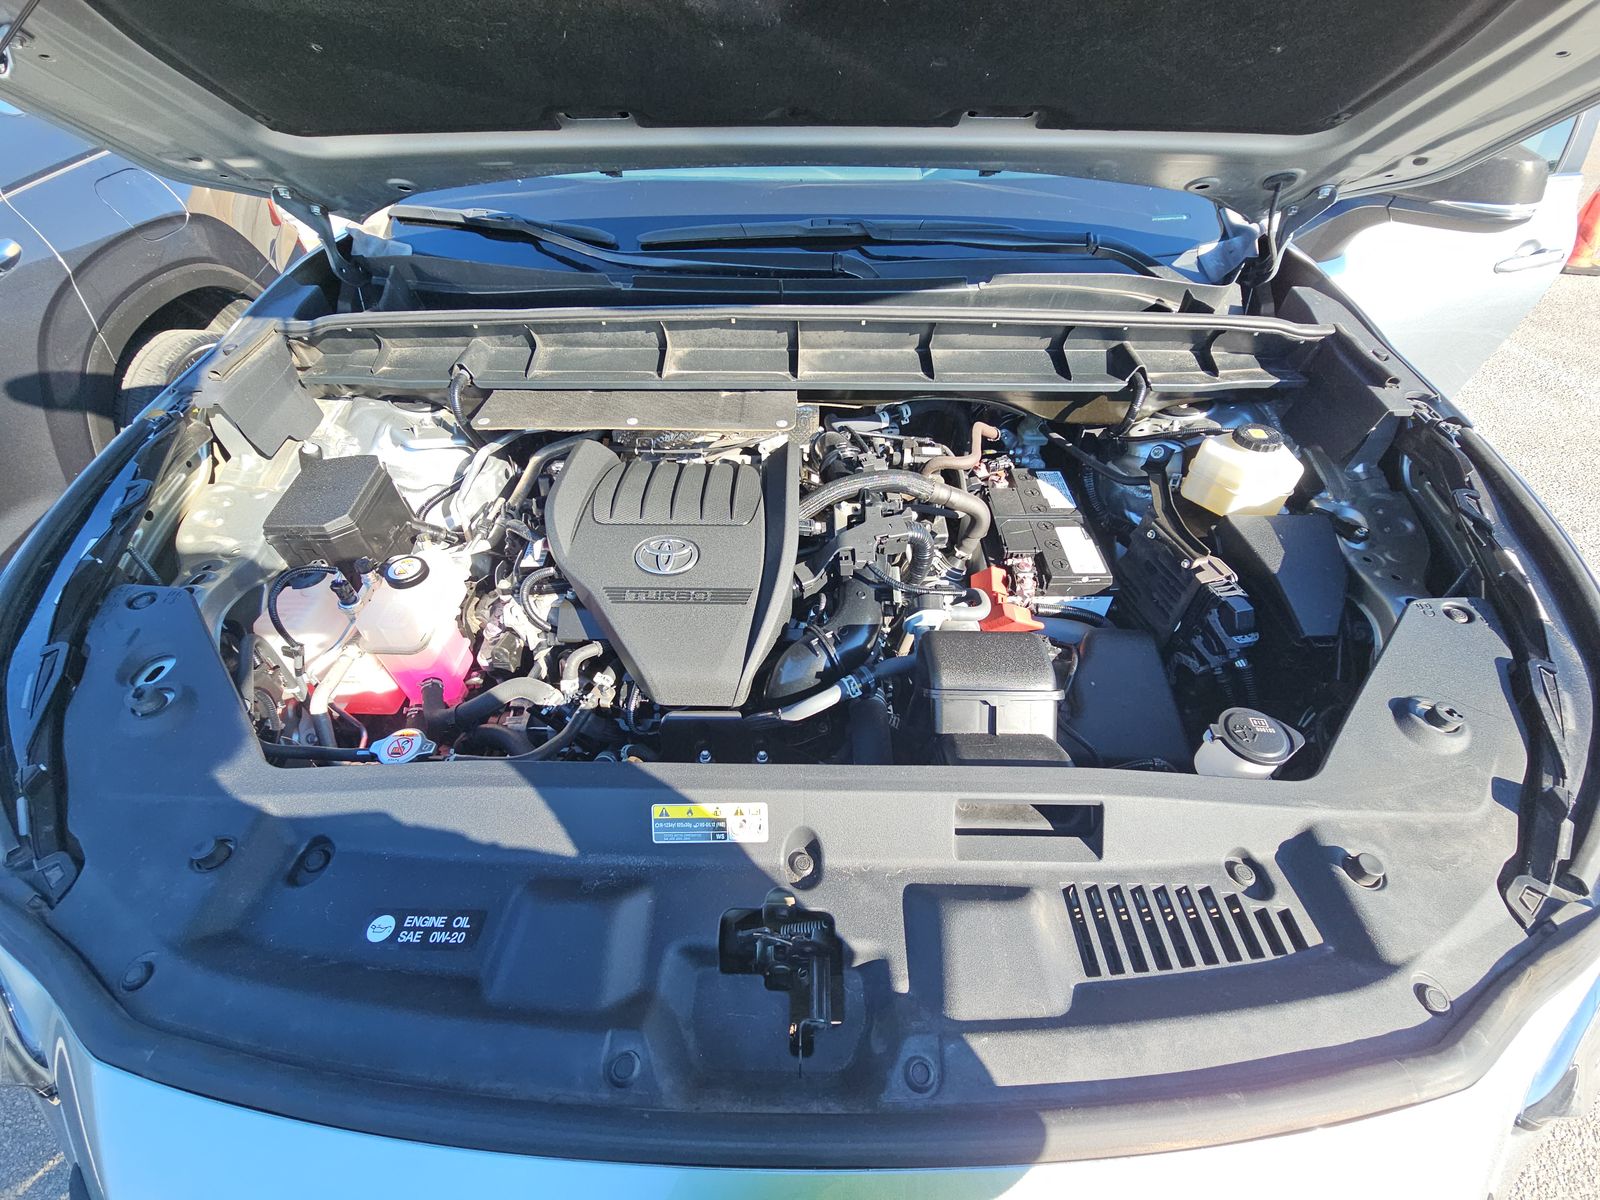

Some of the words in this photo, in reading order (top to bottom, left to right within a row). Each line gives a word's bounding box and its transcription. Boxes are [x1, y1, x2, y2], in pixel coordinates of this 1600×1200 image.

[628, 590, 709, 601] TURBO
[403, 915, 448, 928] ENGINE
[452, 916, 471, 928] OIL
[397, 931, 423, 943] SAE
[429, 931, 466, 943] 0W-20
